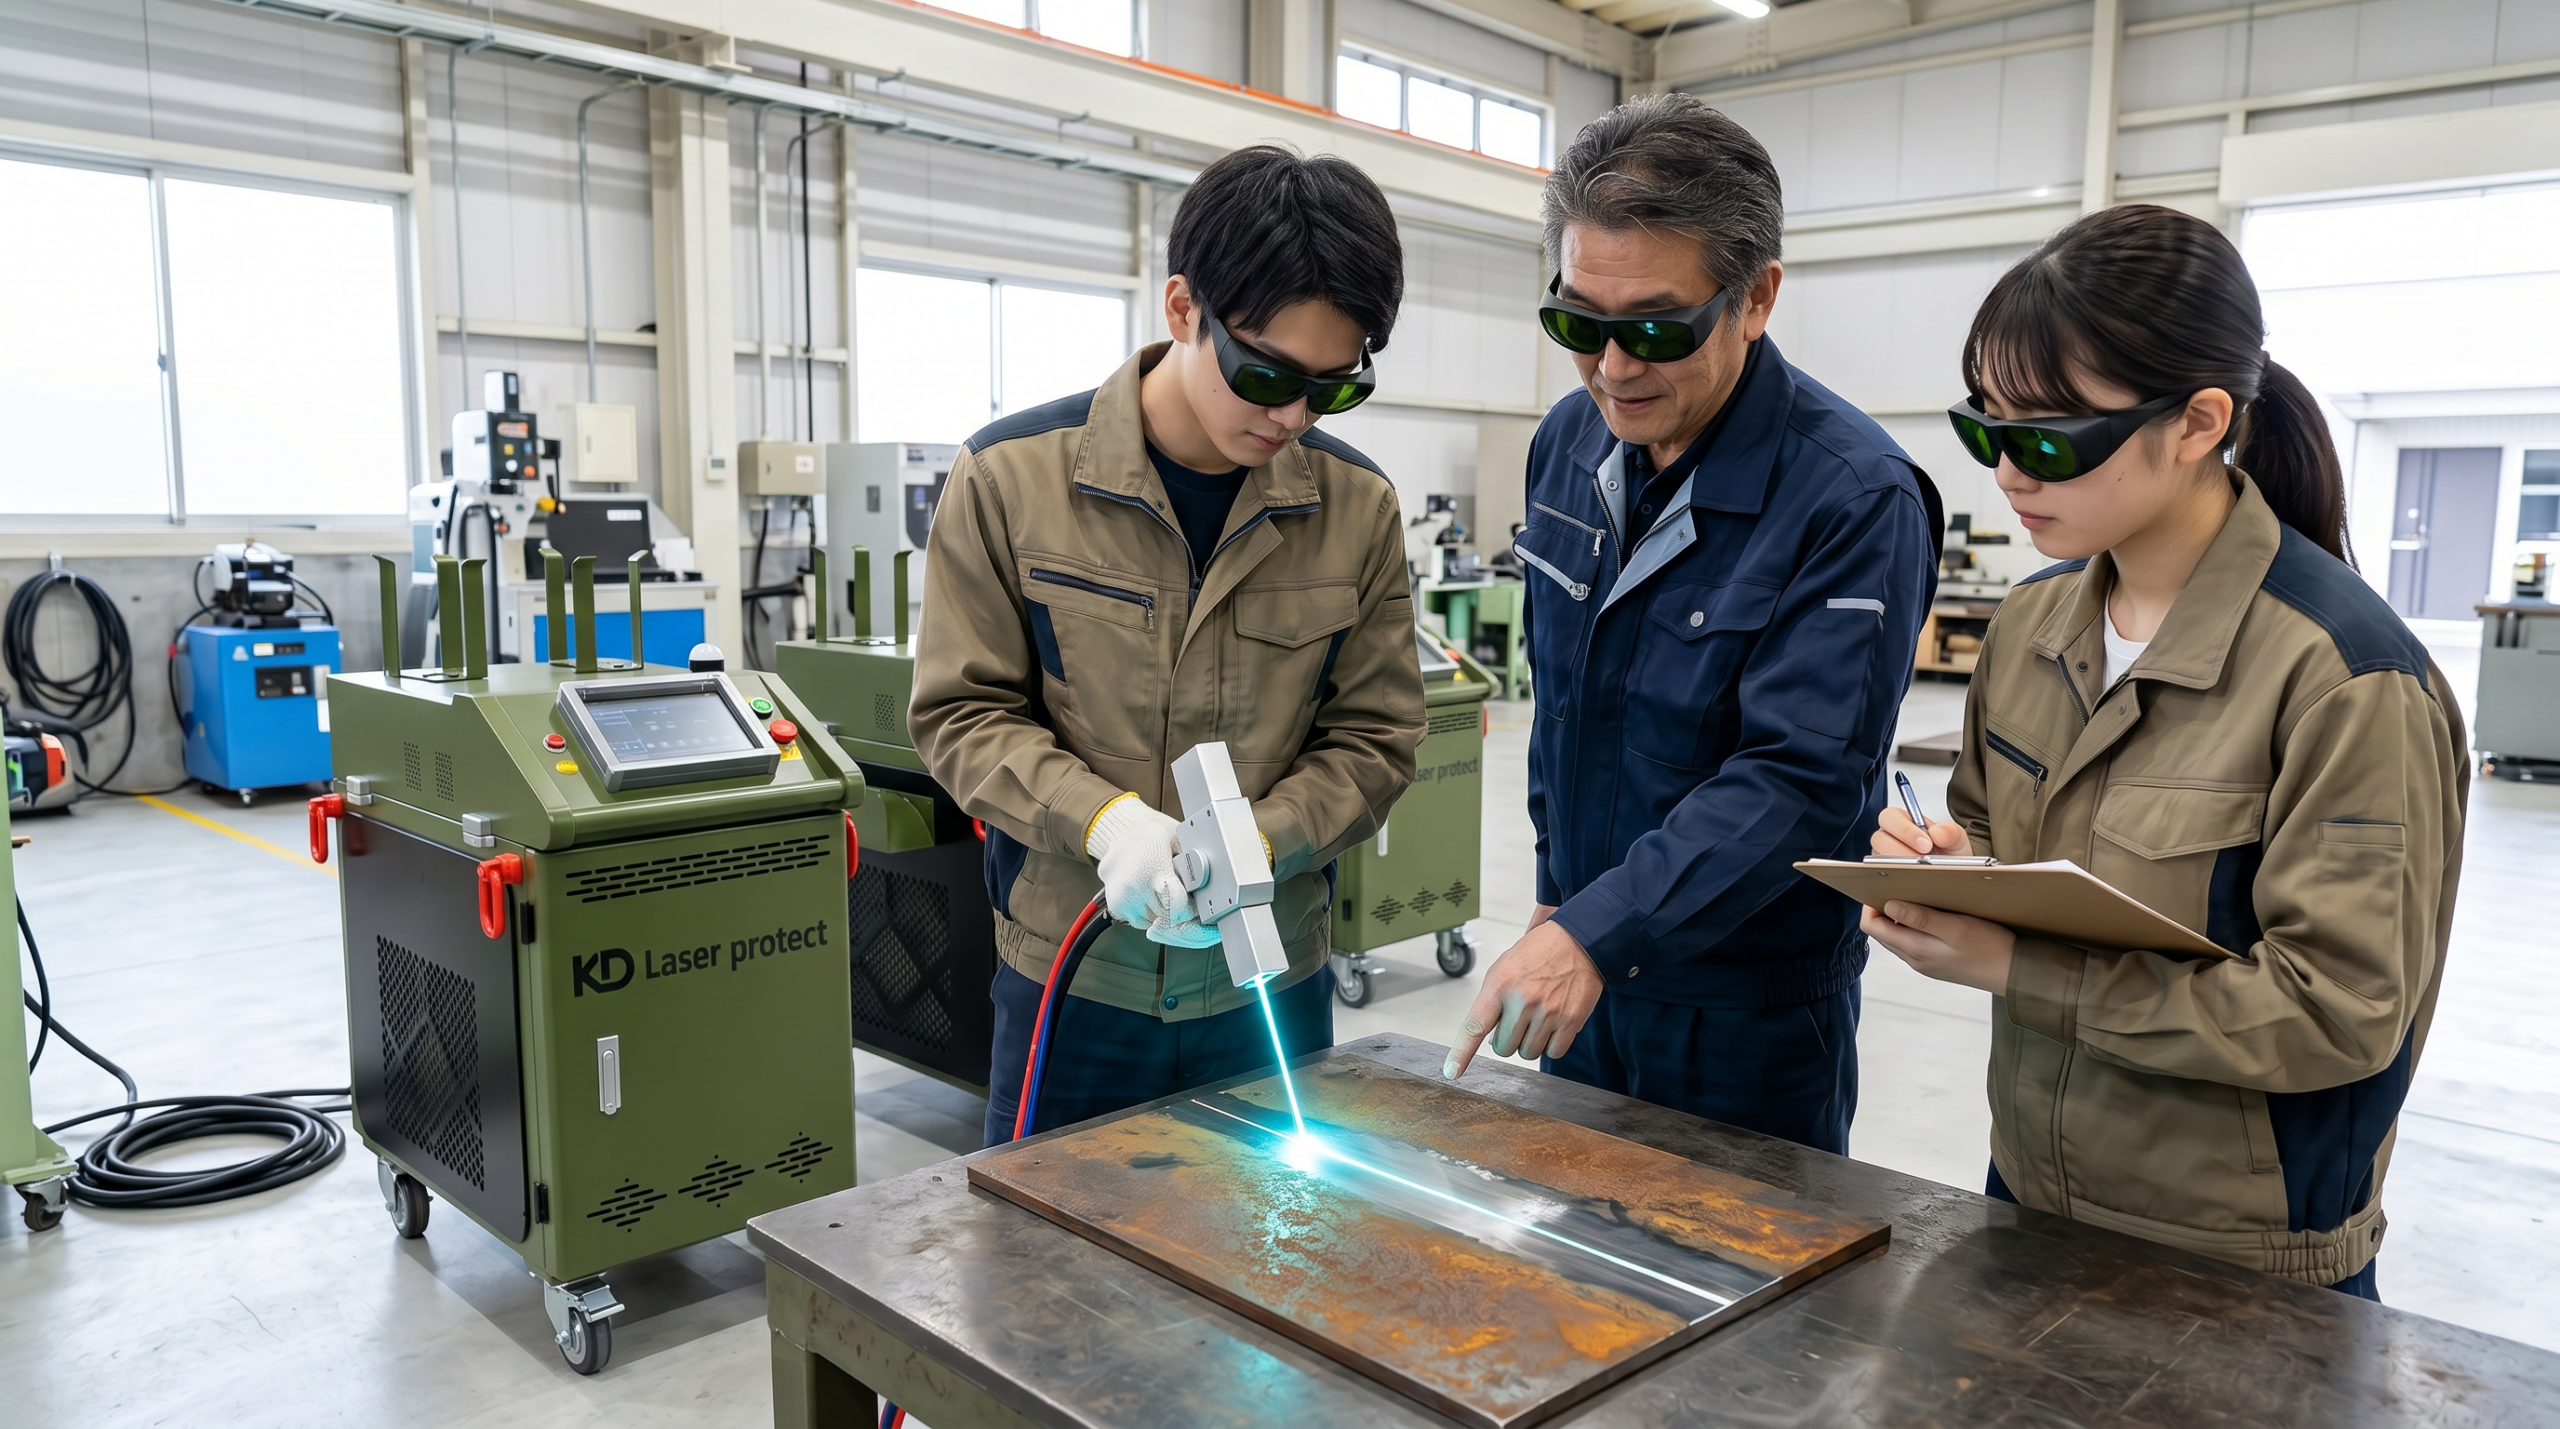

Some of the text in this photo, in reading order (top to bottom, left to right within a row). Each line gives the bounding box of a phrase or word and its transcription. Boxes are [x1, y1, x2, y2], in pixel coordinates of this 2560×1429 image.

[1414, 756, 1478, 784] ser protect
[572, 919, 828, 998] KD Laser protect
